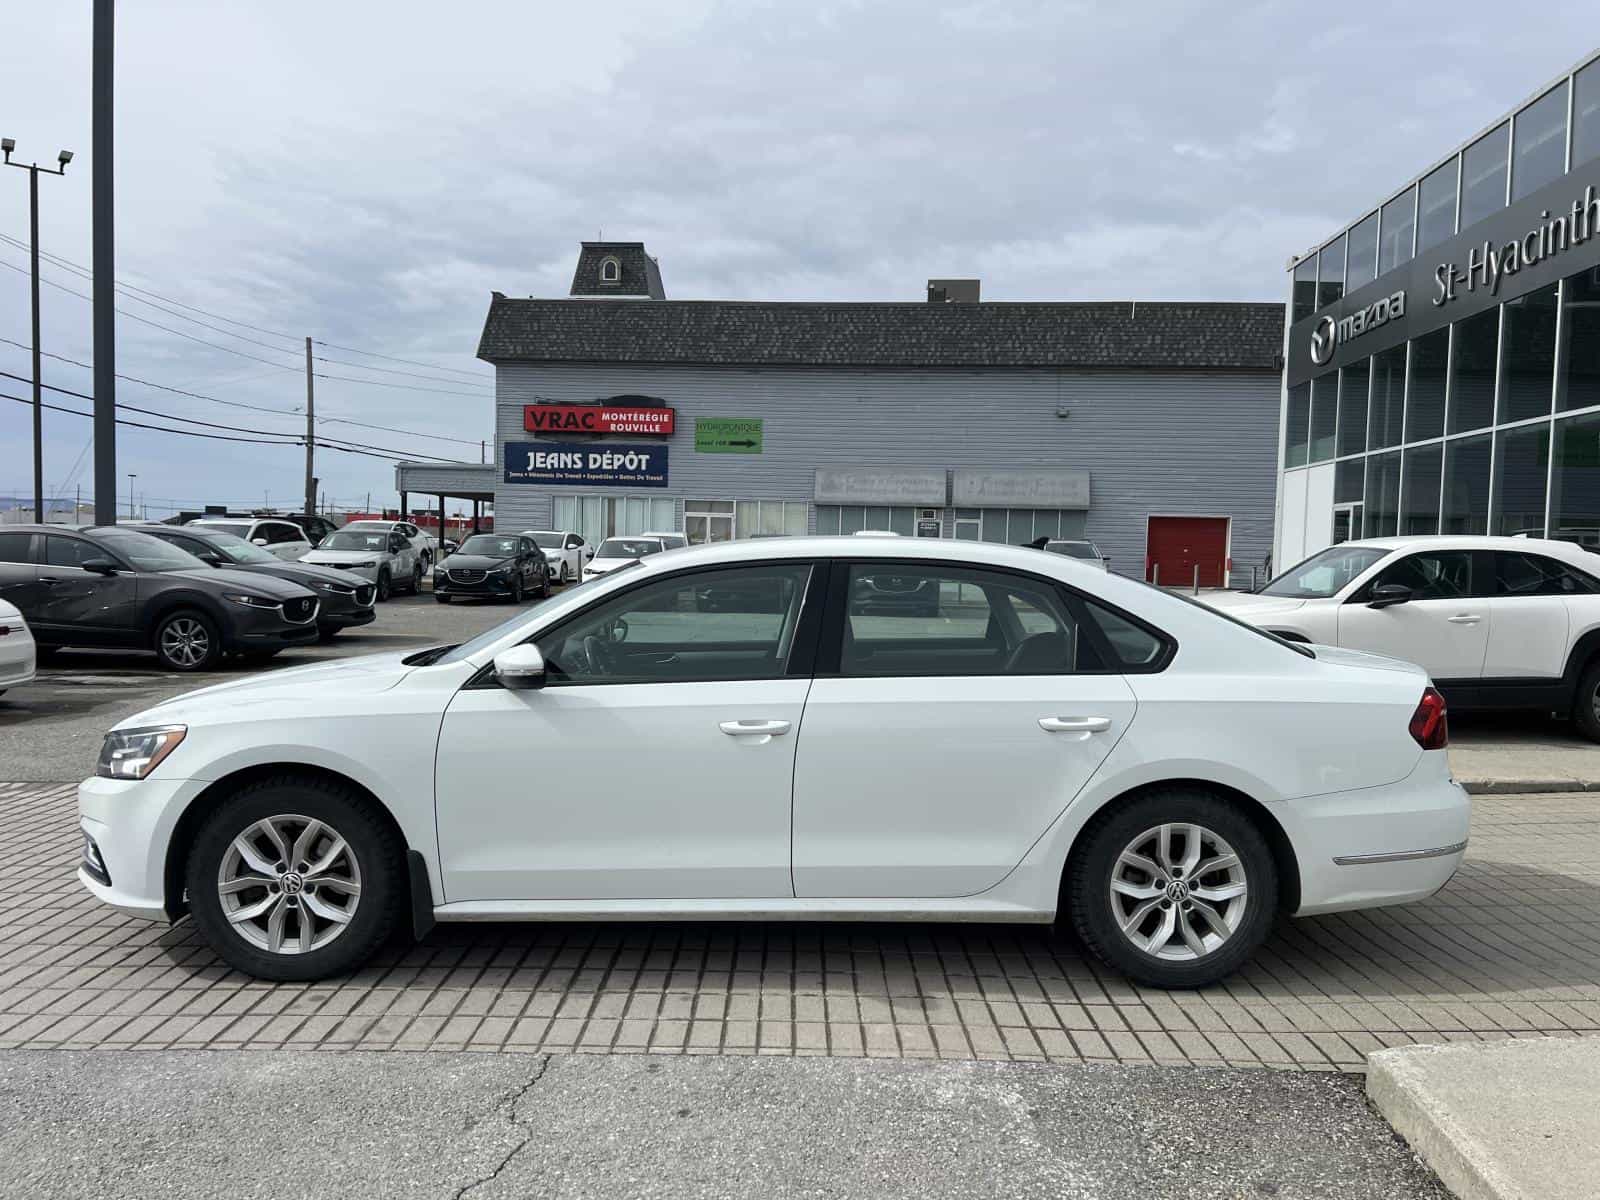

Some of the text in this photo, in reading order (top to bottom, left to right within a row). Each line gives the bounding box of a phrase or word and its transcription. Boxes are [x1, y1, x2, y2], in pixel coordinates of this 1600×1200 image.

[1337, 290, 1405, 344] mazda
[530, 411, 595, 429] VRAC
[601, 412, 670, 422] MONTÉRÉGIE
[610, 423, 661, 432] ROUVILLE
[527, 450, 650, 471] JEANS DÉPÔT
